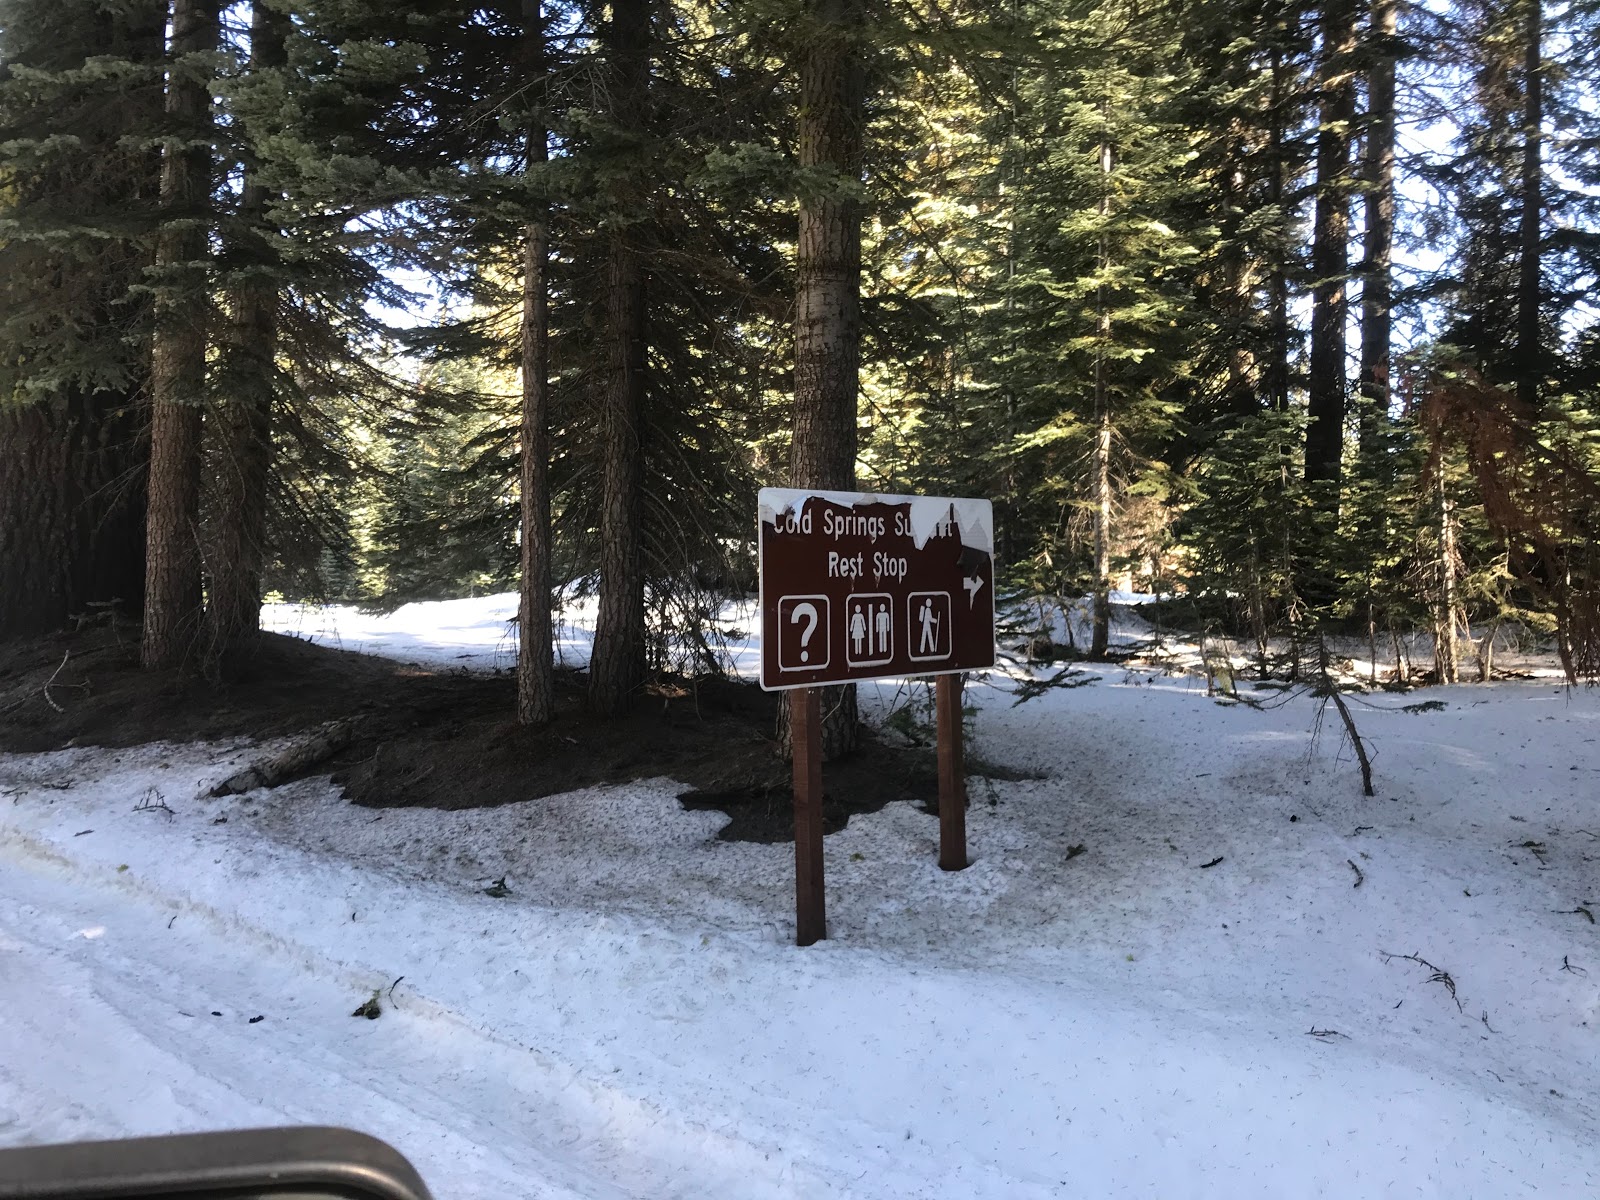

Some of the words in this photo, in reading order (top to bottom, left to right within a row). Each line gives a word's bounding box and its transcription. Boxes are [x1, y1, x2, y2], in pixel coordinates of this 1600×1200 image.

[823, 508, 886, 543] Springs
[894, 511, 955, 538] Sut
[828, 551, 864, 578] Rest
[872, 551, 908, 583] Stop
